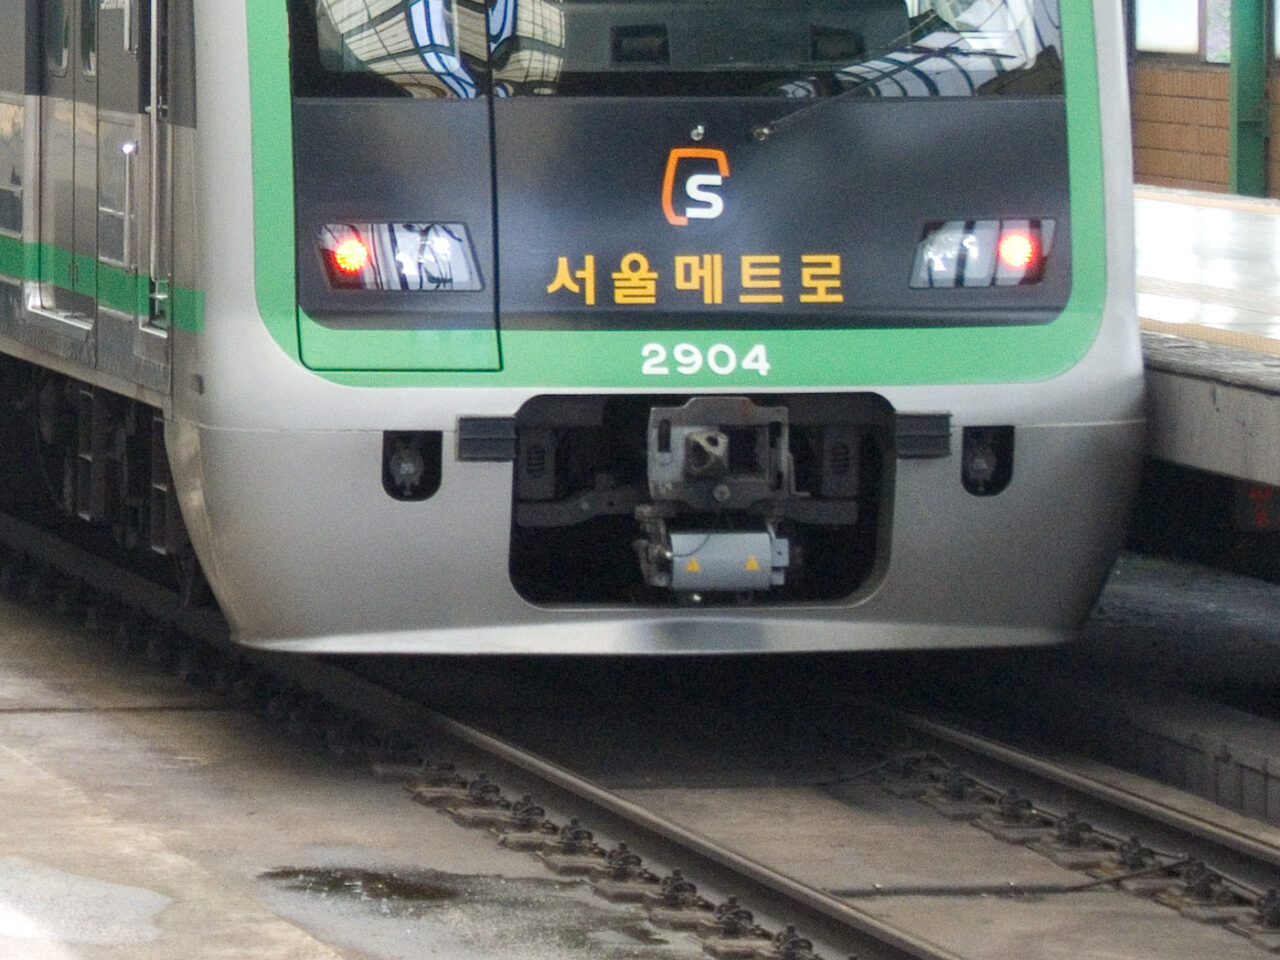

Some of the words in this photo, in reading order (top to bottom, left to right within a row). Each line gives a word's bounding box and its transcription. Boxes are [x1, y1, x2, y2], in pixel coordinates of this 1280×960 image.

[685, 173, 724, 219] S
[546, 252, 844, 305] 서울메트로
[640, 343, 770, 376] 2904
